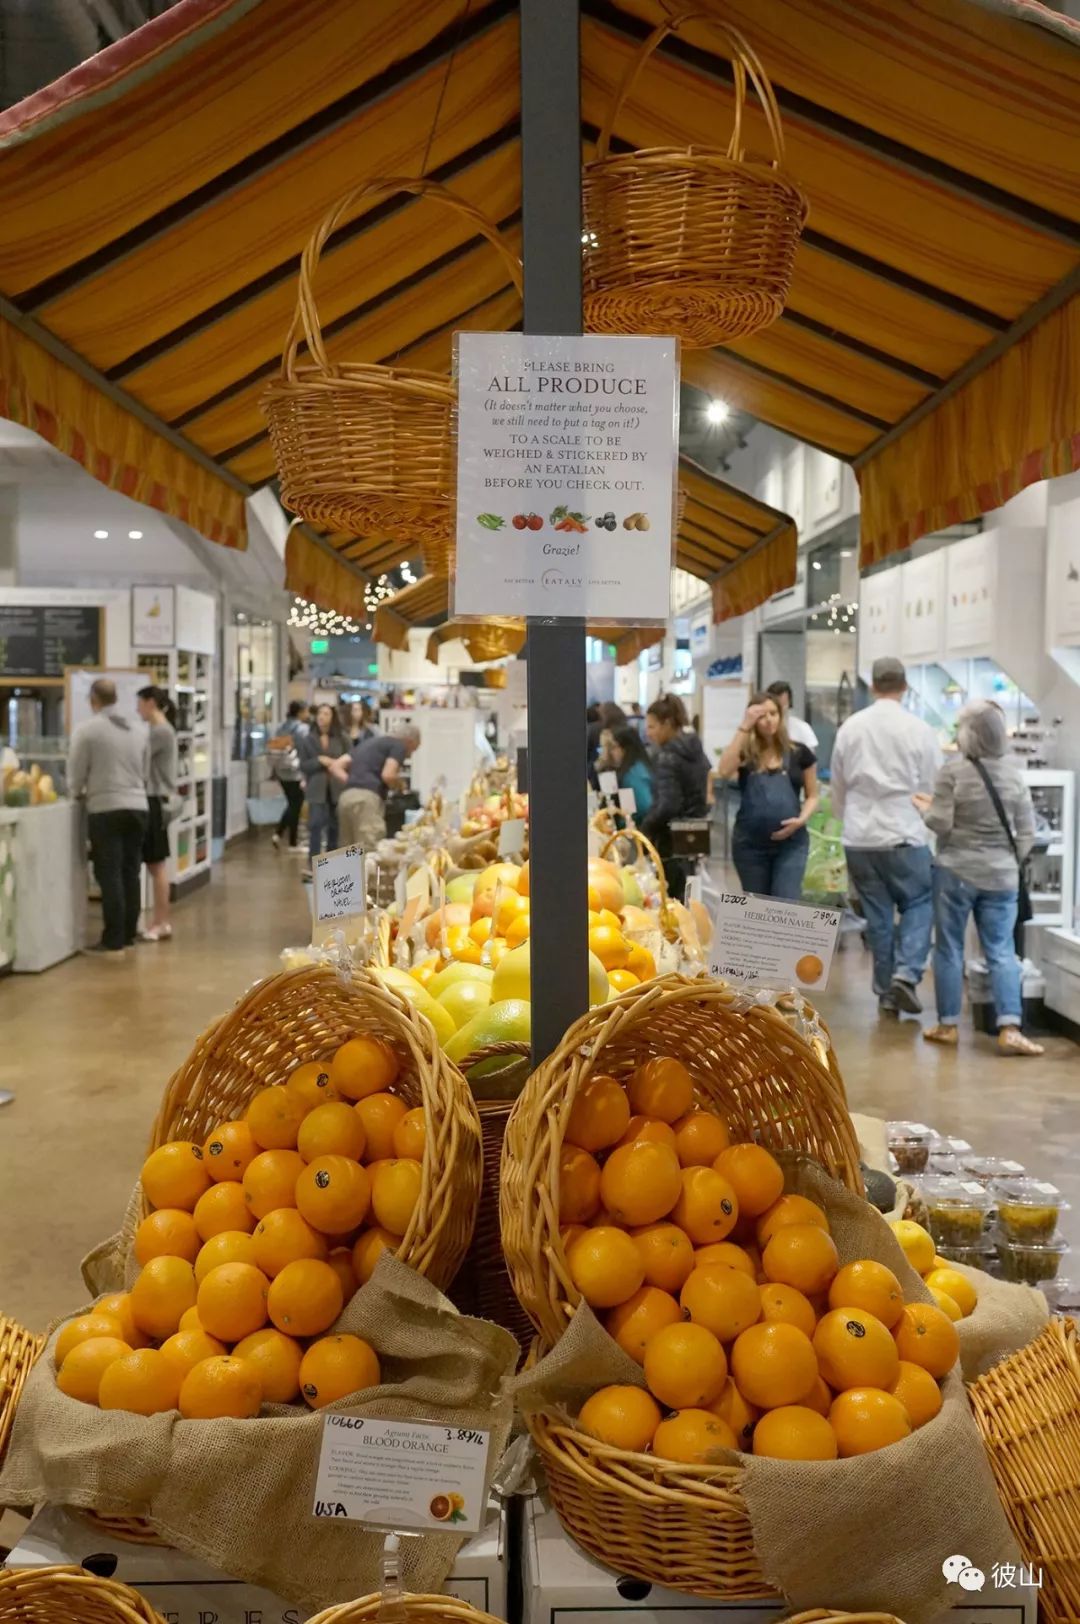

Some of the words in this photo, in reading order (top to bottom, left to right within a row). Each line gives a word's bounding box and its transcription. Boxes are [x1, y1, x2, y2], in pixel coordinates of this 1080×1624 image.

[524, 361, 570, 372] PLEASE
[574, 362, 615, 373] BRING
[487, 376, 531, 392] ALL
[537, 377, 648, 395] PRODUCE
[484, 399, 497, 412] (It
[499, 400, 533, 412] doesn't
[535, 402, 567, 412] matter
[568, 402, 592, 413] what
[591, 405, 611, 416] you
[613, 402, 648, 414] choose,
[492, 418, 506, 426] we
[506, 416, 525, 426] still
[527, 416, 550, 427] need
[552, 417, 561, 427] to
[563, 417, 580, 430] put
[582, 420, 588, 428] a
[591, 419, 605, 432] tag
[607, 420, 620, 428] on
[623, 418, 640, 429] it!)
[509, 434, 528, 444] TO
[530, 434, 540, 444] A
[542, 435, 582, 445] SCALE
[585, 436, 603, 446] TO
[606, 436, 622, 446] BE
[483, 448, 543, 459] WEIGHED
[546, 449, 554, 459] &
[558, 450, 628, 461] STICKERED
[631, 451, 648, 462] BY
[524, 464, 543, 474] AN
[545, 465, 606, 475] EATALIAN
[484, 478, 532, 489] BEFORE
[535, 479, 563, 489] YOU
[566, 480, 611, 490] CHECK
[614, 480, 645, 491] OUT.
[542, 543, 580, 556] Grazie!
[720, 893, 748, 906] 12202
[744, 911, 788, 925] HEIRLOOM
[788, 917, 817, 929] NAVEL
[326, 1415, 365, 1430] 10660
[362, 1435, 400, 1450] BLOOD
[402, 1439, 449, 1454] ORANGE
[315, 1501, 348, 1517] USA
